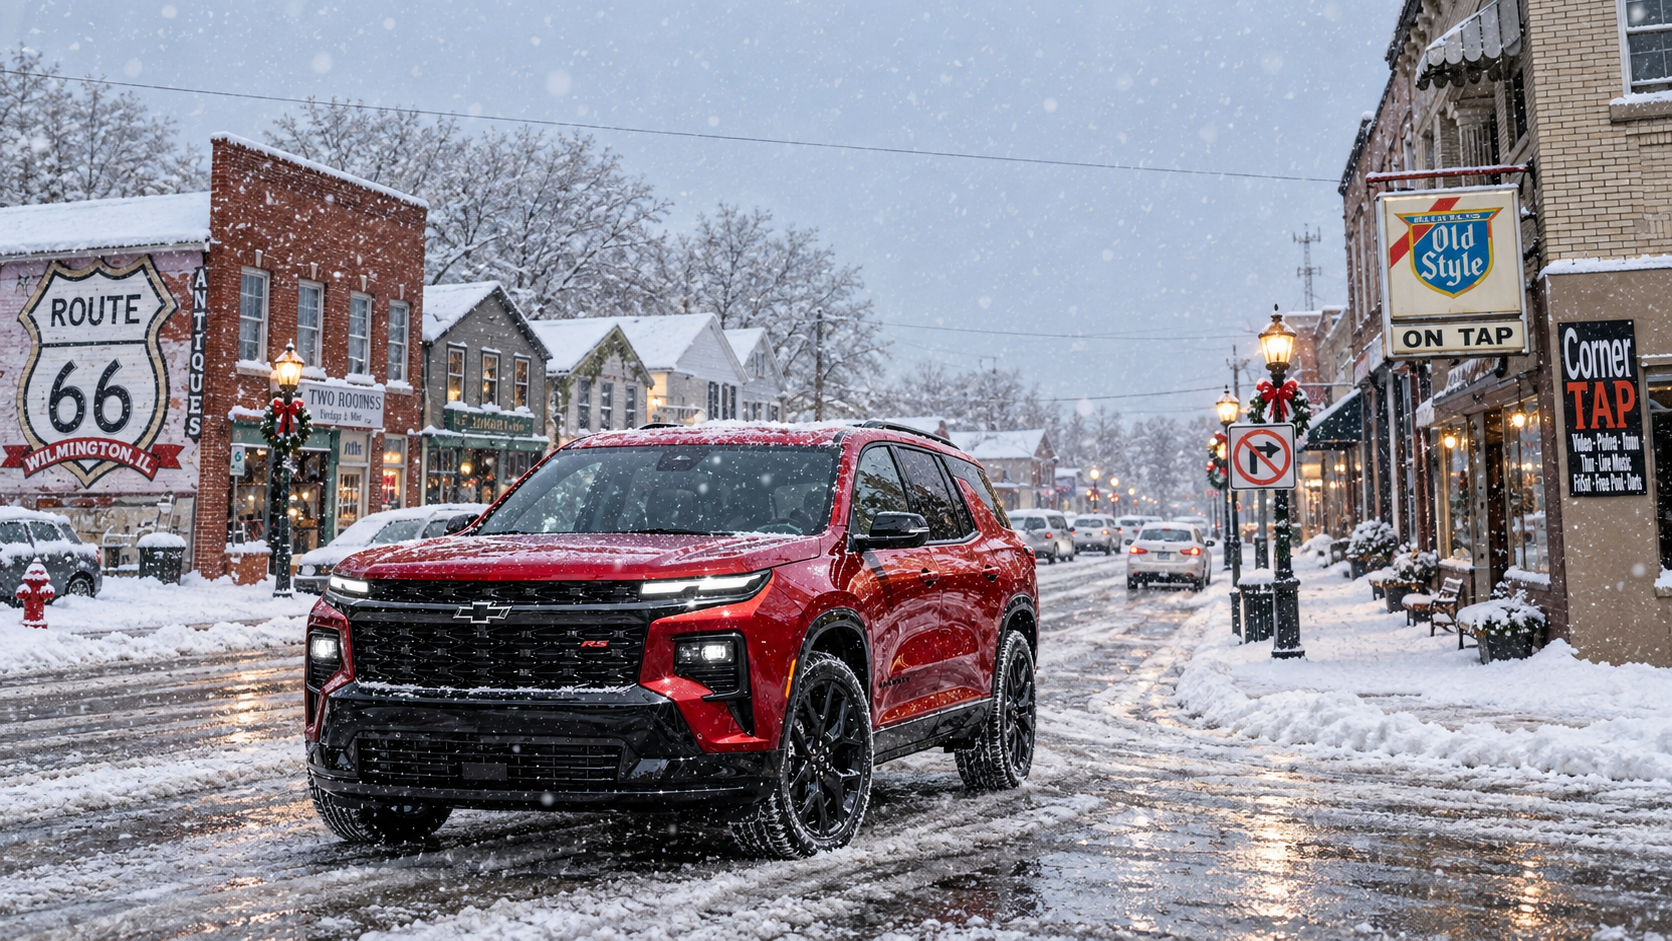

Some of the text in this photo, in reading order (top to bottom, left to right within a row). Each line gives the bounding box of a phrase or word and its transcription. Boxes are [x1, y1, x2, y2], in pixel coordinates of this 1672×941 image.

[1432, 224, 1477, 252] Old
[1421, 251, 1483, 287] Style
[50, 294, 142, 327] ROUTE
[188, 268, 207, 435] ANTIQUES
[1402, 327, 1513, 348] ON TAP
[1563, 327, 1632, 380] Corner
[48, 359, 133, 435] 66
[309, 389, 335, 407] TWO
[1566, 380, 1636, 430] TAP
[24, 440, 152, 474] WILMINGTON, IL
[580, 640, 610, 648] RS
